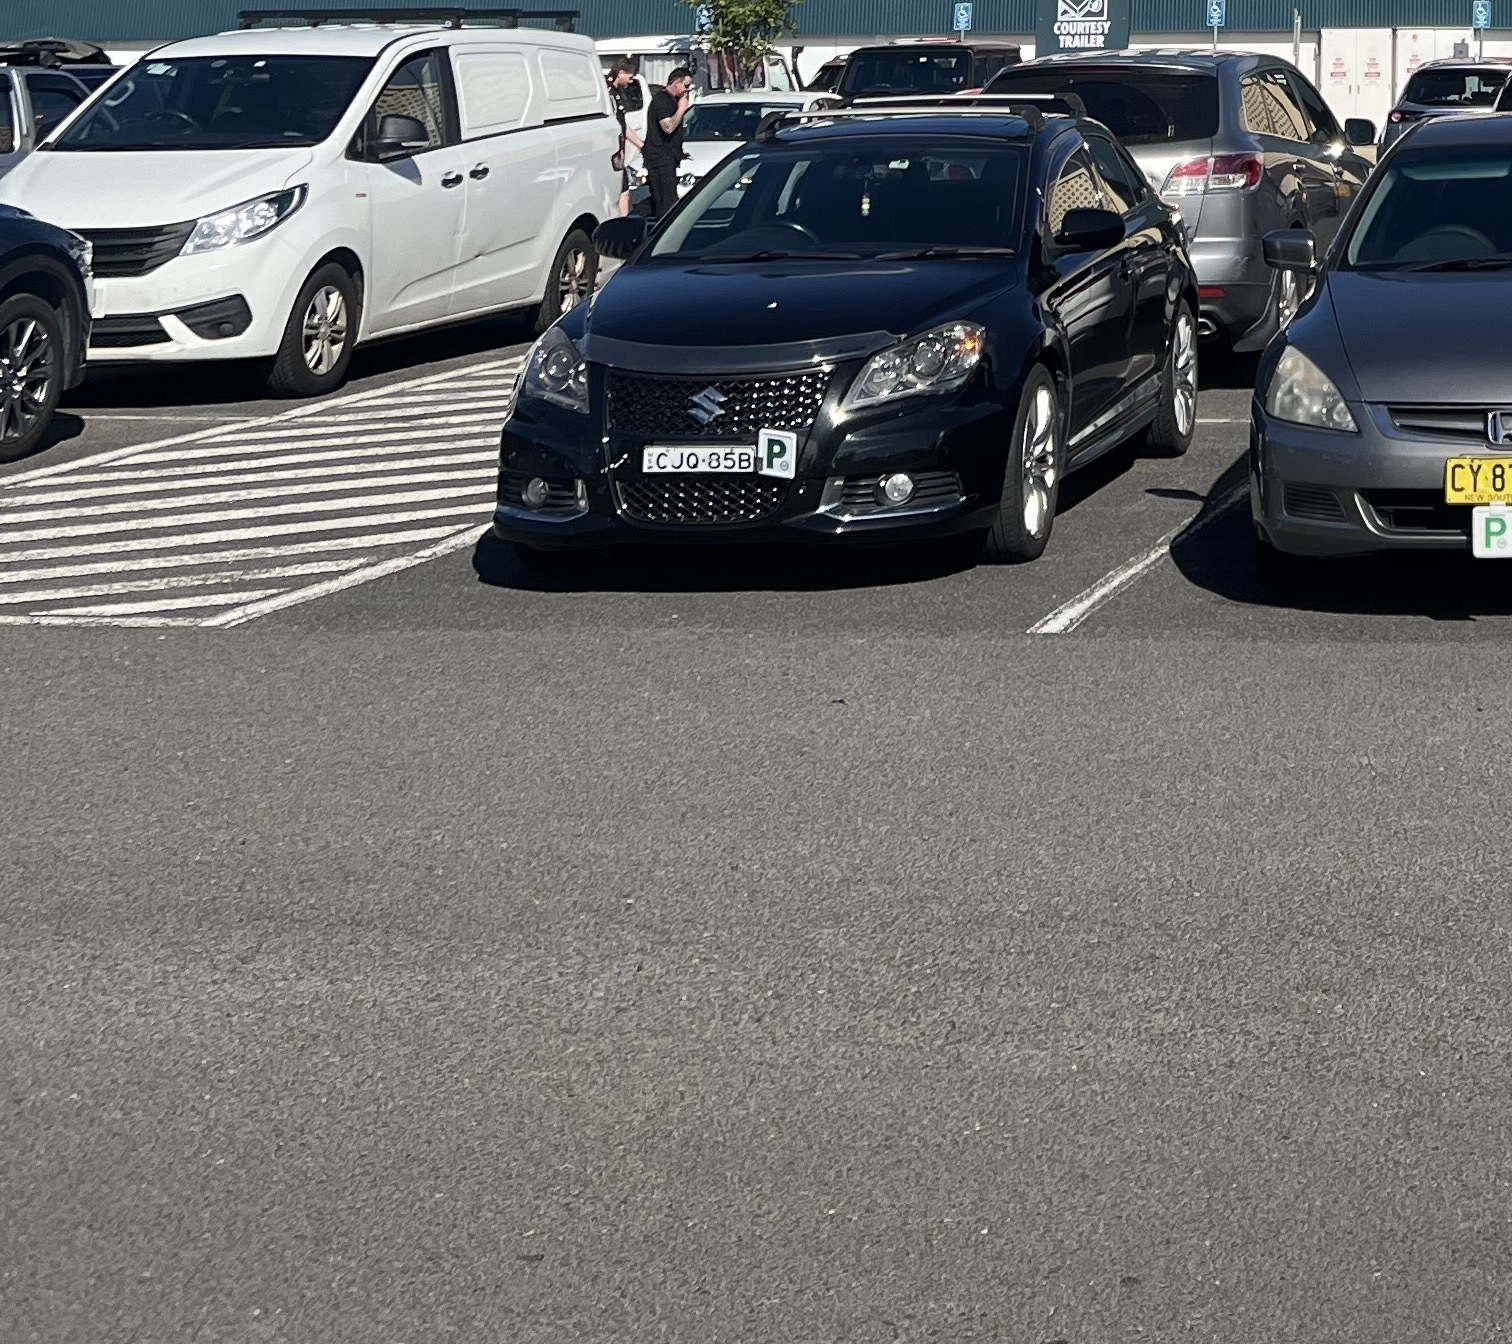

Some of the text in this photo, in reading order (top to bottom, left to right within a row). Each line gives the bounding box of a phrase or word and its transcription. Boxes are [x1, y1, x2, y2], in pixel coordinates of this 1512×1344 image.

[1053, 21, 1111, 35] COURTESY
[1058, 35, 1105, 48] TRAILER
[766, 438, 787, 469] P
[1485, 517, 1507, 549] P
